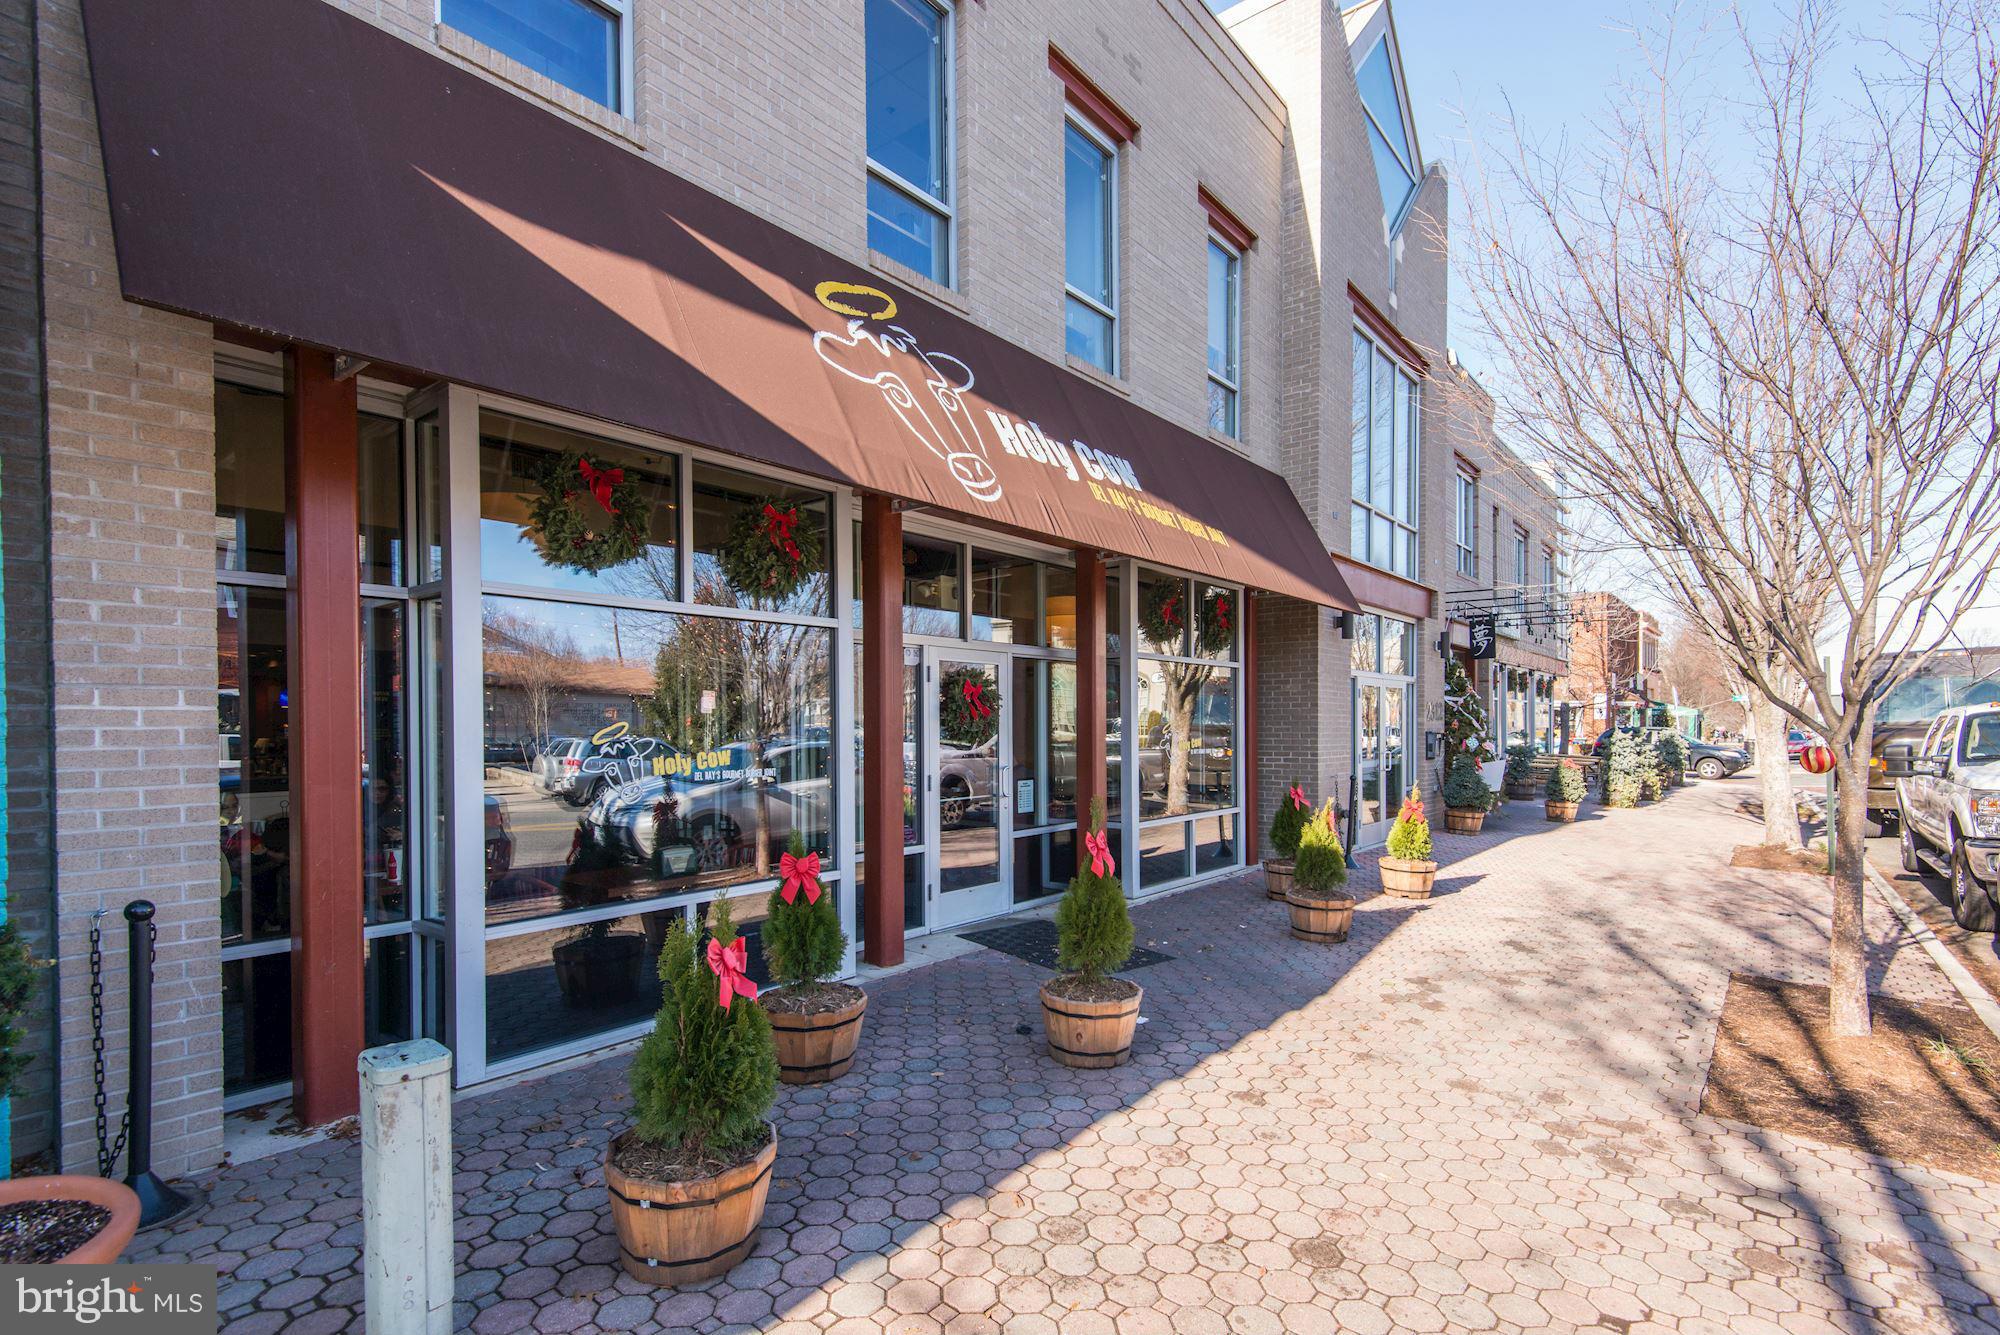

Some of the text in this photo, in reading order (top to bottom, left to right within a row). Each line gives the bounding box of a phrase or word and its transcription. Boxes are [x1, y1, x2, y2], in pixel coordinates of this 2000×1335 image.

[985, 408, 1079, 482] Holy
[652, 749, 731, 776] Holy Cow
